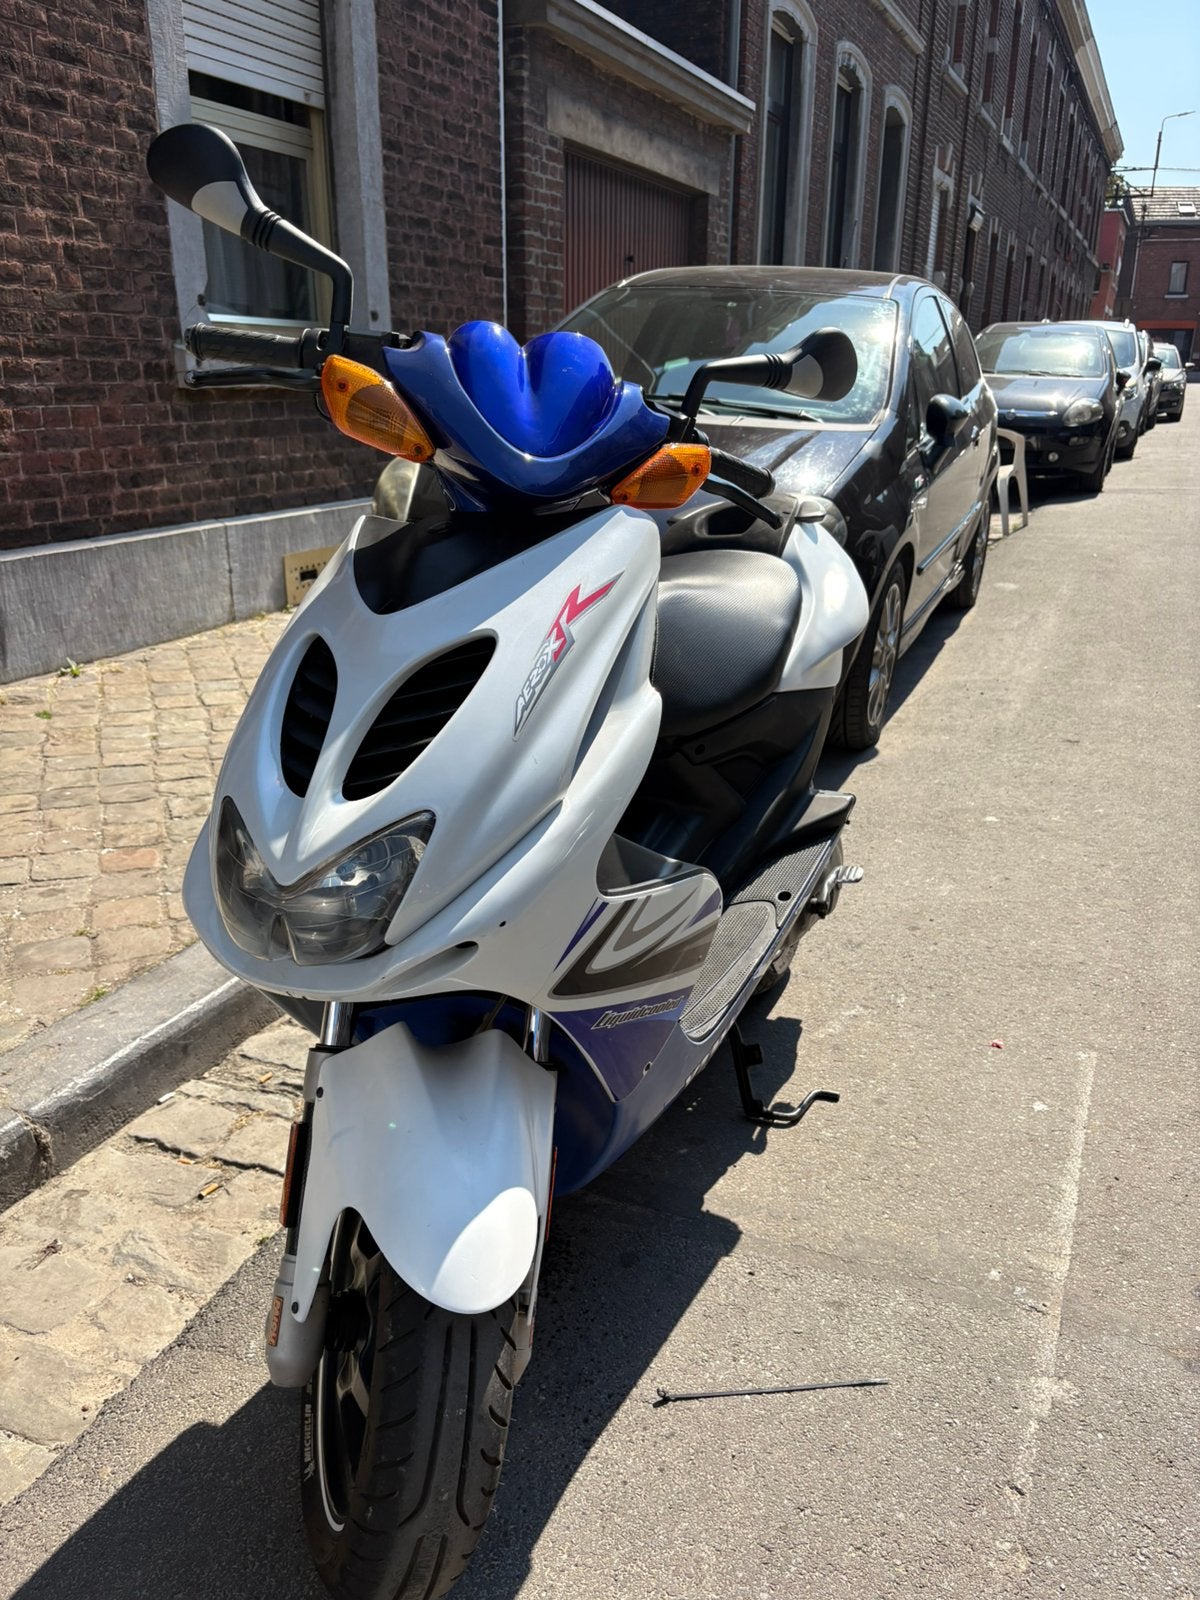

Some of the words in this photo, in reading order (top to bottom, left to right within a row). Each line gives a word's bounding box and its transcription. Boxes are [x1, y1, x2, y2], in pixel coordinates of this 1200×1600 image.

[514, 627, 564, 735] AEROX
[590, 997, 683, 1030] Liquidcooled
[304, 1403, 312, 1463] MICHELIN
